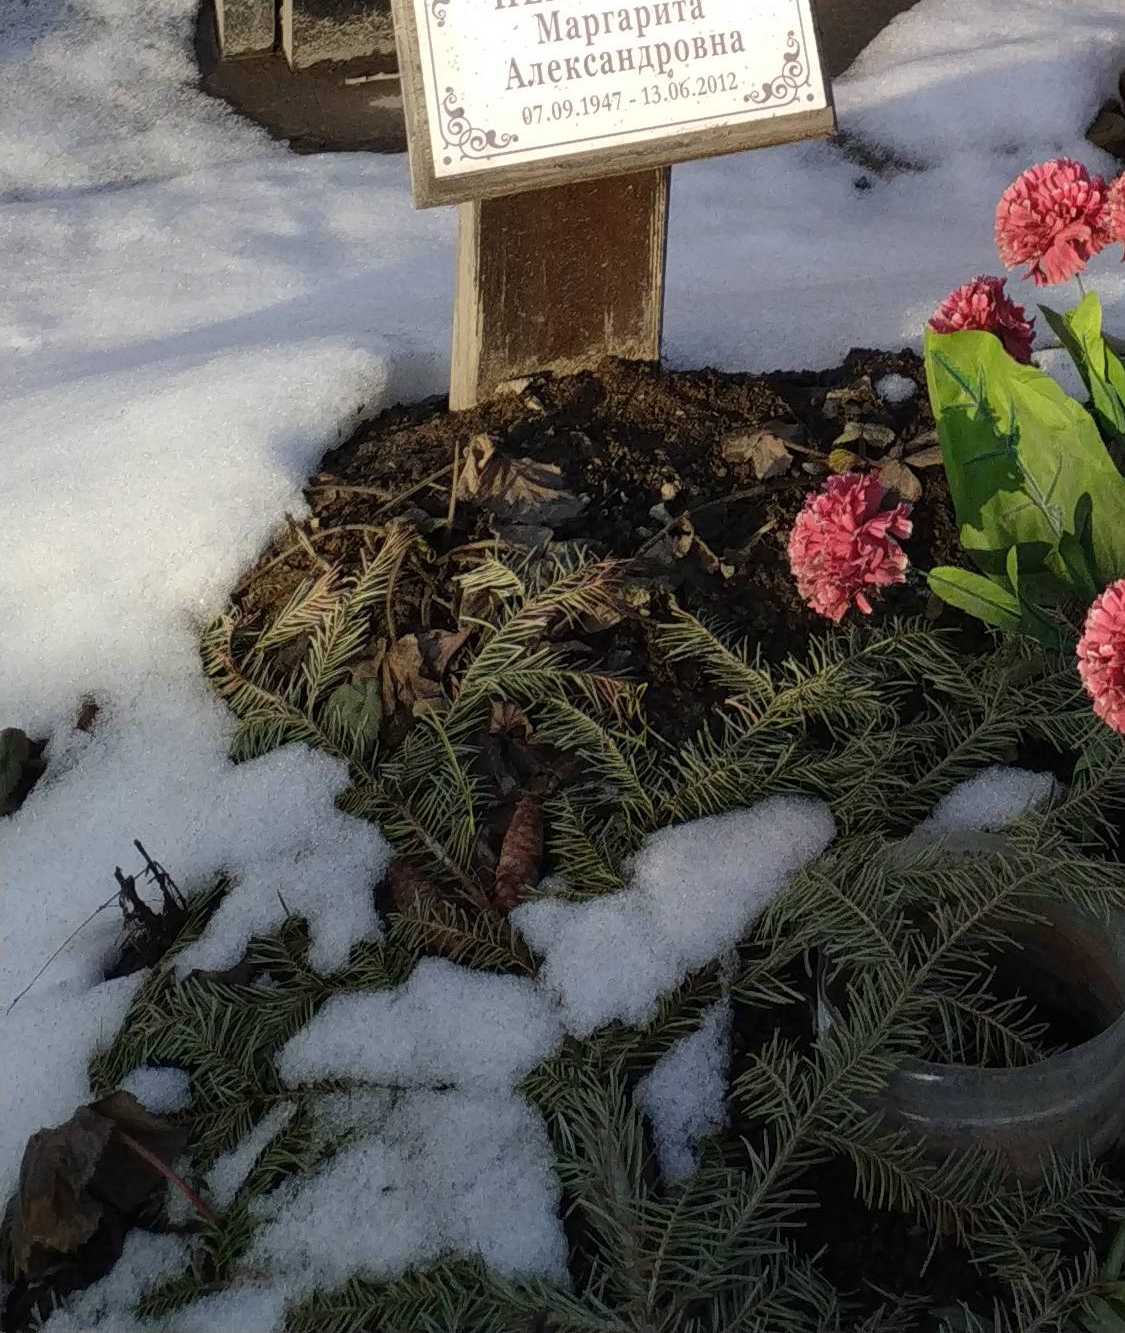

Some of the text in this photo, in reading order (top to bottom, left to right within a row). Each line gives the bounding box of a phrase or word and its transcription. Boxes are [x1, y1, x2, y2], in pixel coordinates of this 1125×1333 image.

[504, 29, 746, 91] Александровна
[521, 90, 622, 126] 07.09.1947
[641, 71, 739, 107] 13.06.2012
